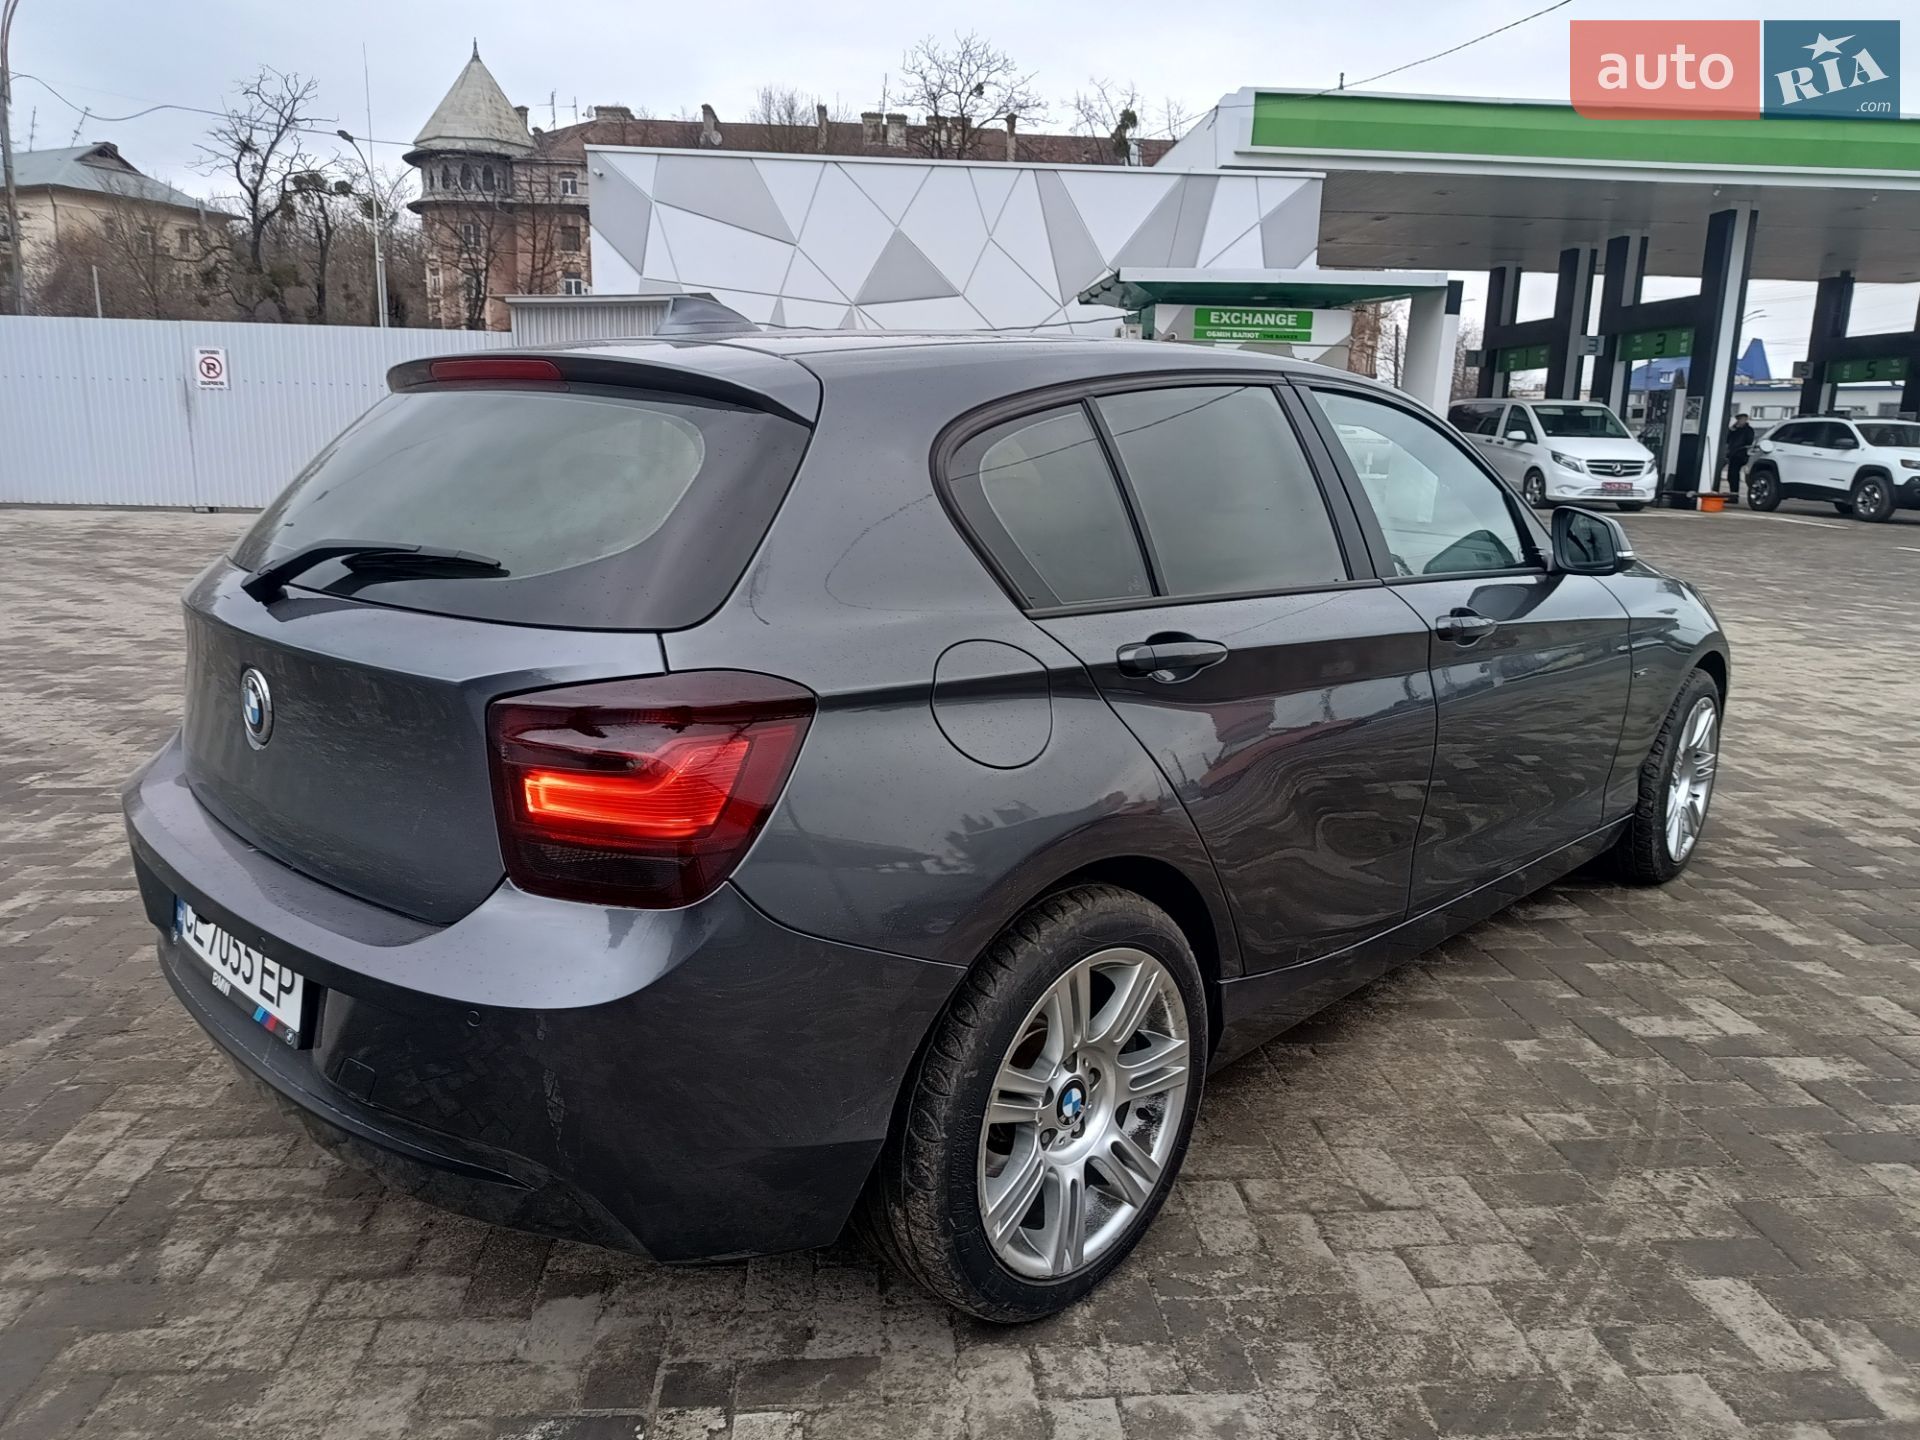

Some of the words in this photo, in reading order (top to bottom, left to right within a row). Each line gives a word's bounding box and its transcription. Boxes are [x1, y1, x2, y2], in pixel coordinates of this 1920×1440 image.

[1210, 311, 1298, 326] EXCHANGE
[1232, 331, 1259, 339] ВАЛЮТ
[1655, 333, 1667, 355] 3
